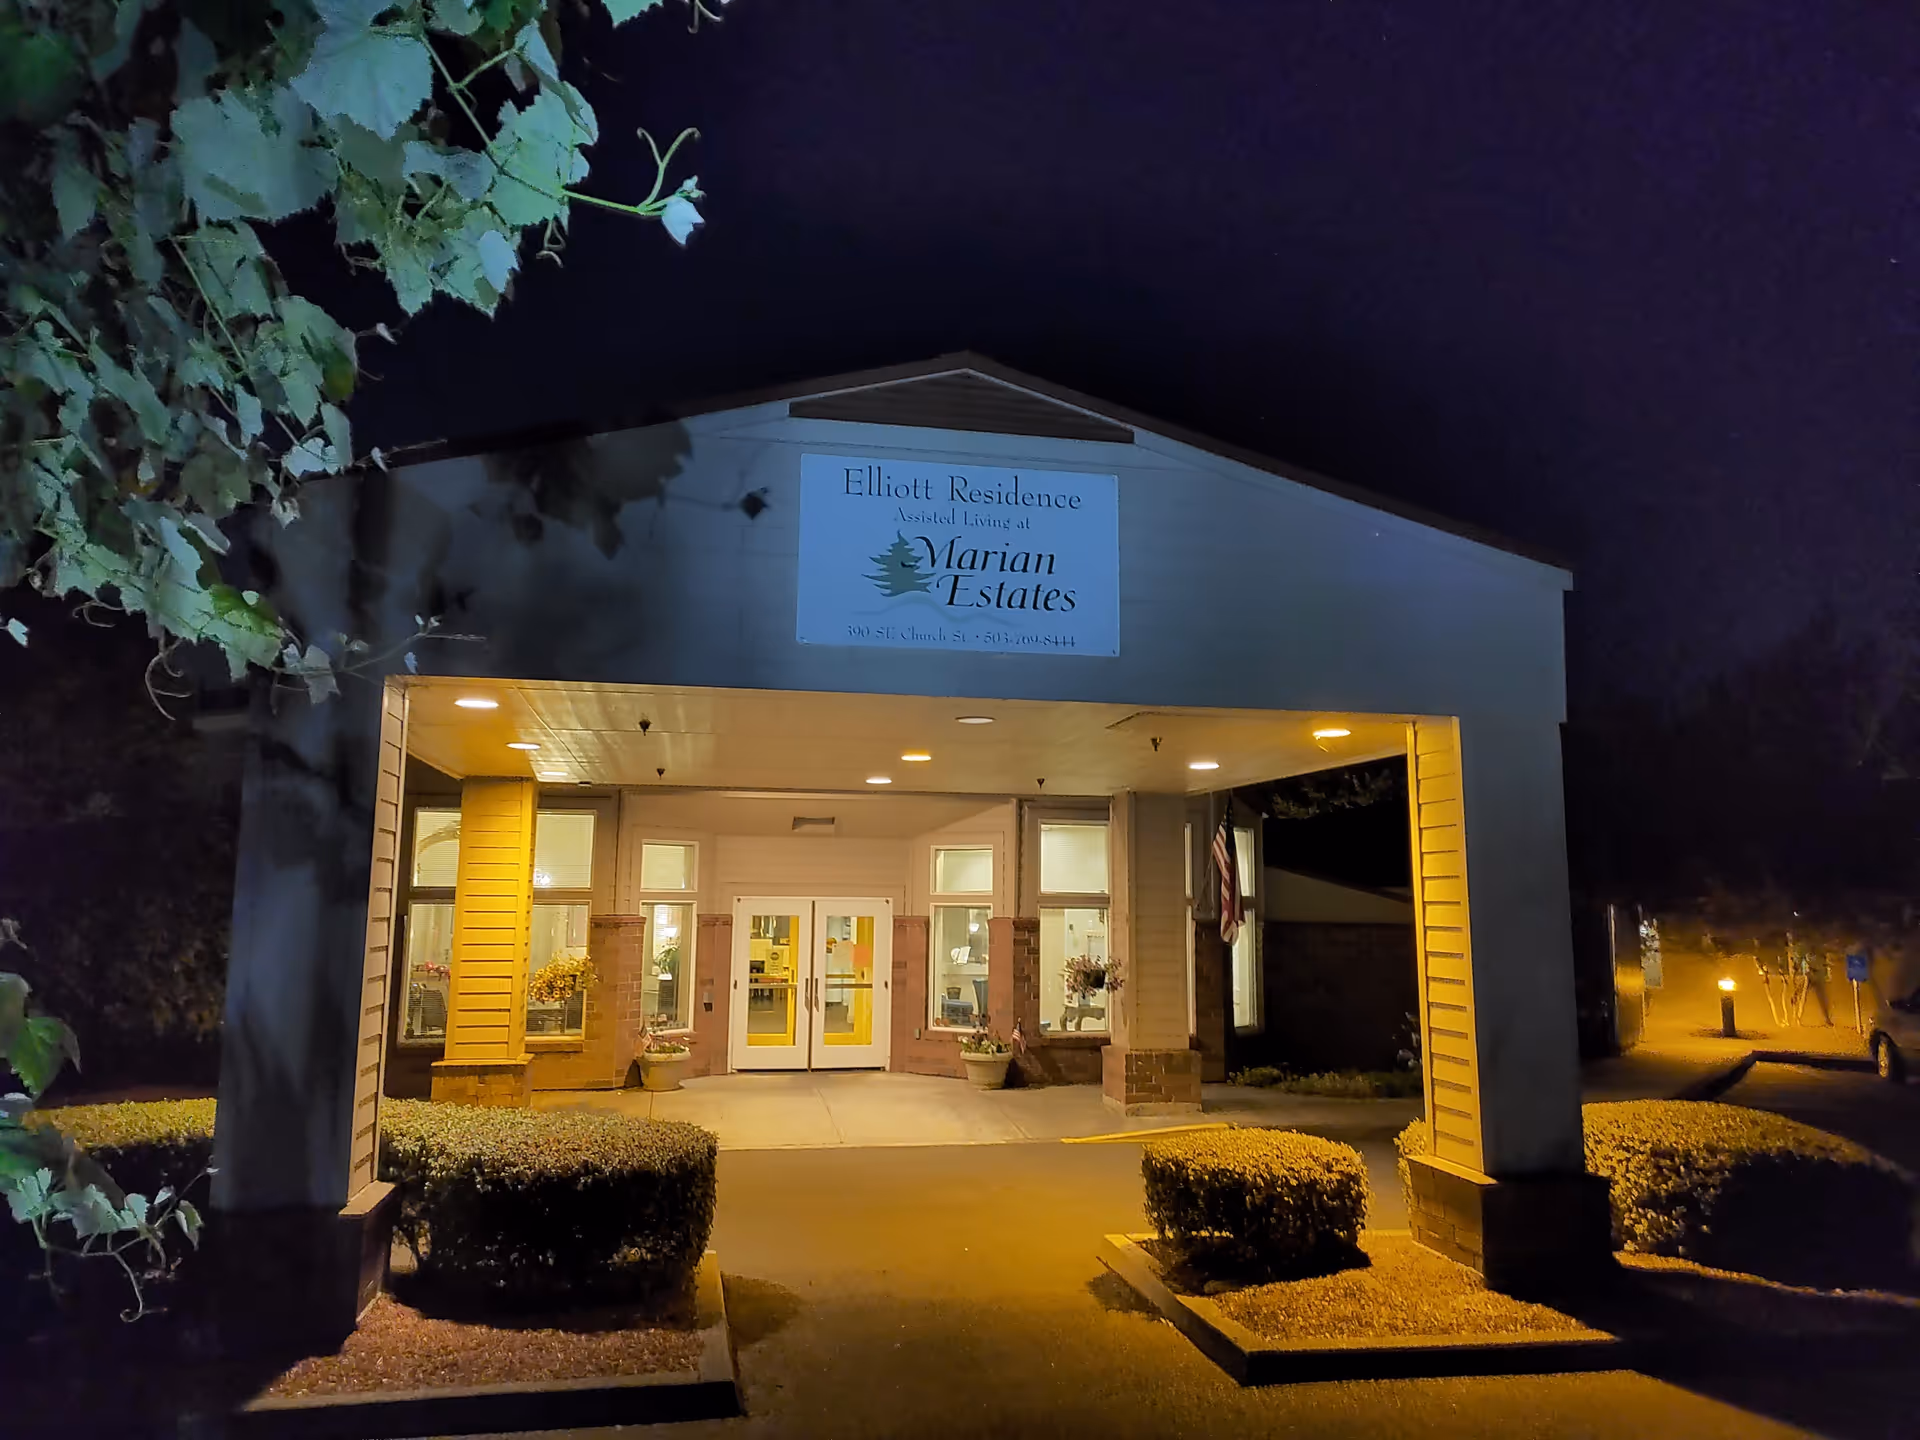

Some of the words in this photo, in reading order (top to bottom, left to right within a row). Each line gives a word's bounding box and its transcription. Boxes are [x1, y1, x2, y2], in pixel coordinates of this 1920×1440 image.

[844, 465, 933, 500] Elliott
[948, 475, 1082, 510] Residence
[894, 507, 955, 525] Assisted
[964, 511, 1010, 531] Living
[1017, 517, 1030, 530] at
[902, 535, 1055, 575] Marian
[936, 574, 1077, 613] Estates
[900, 626, 946, 641] Church
